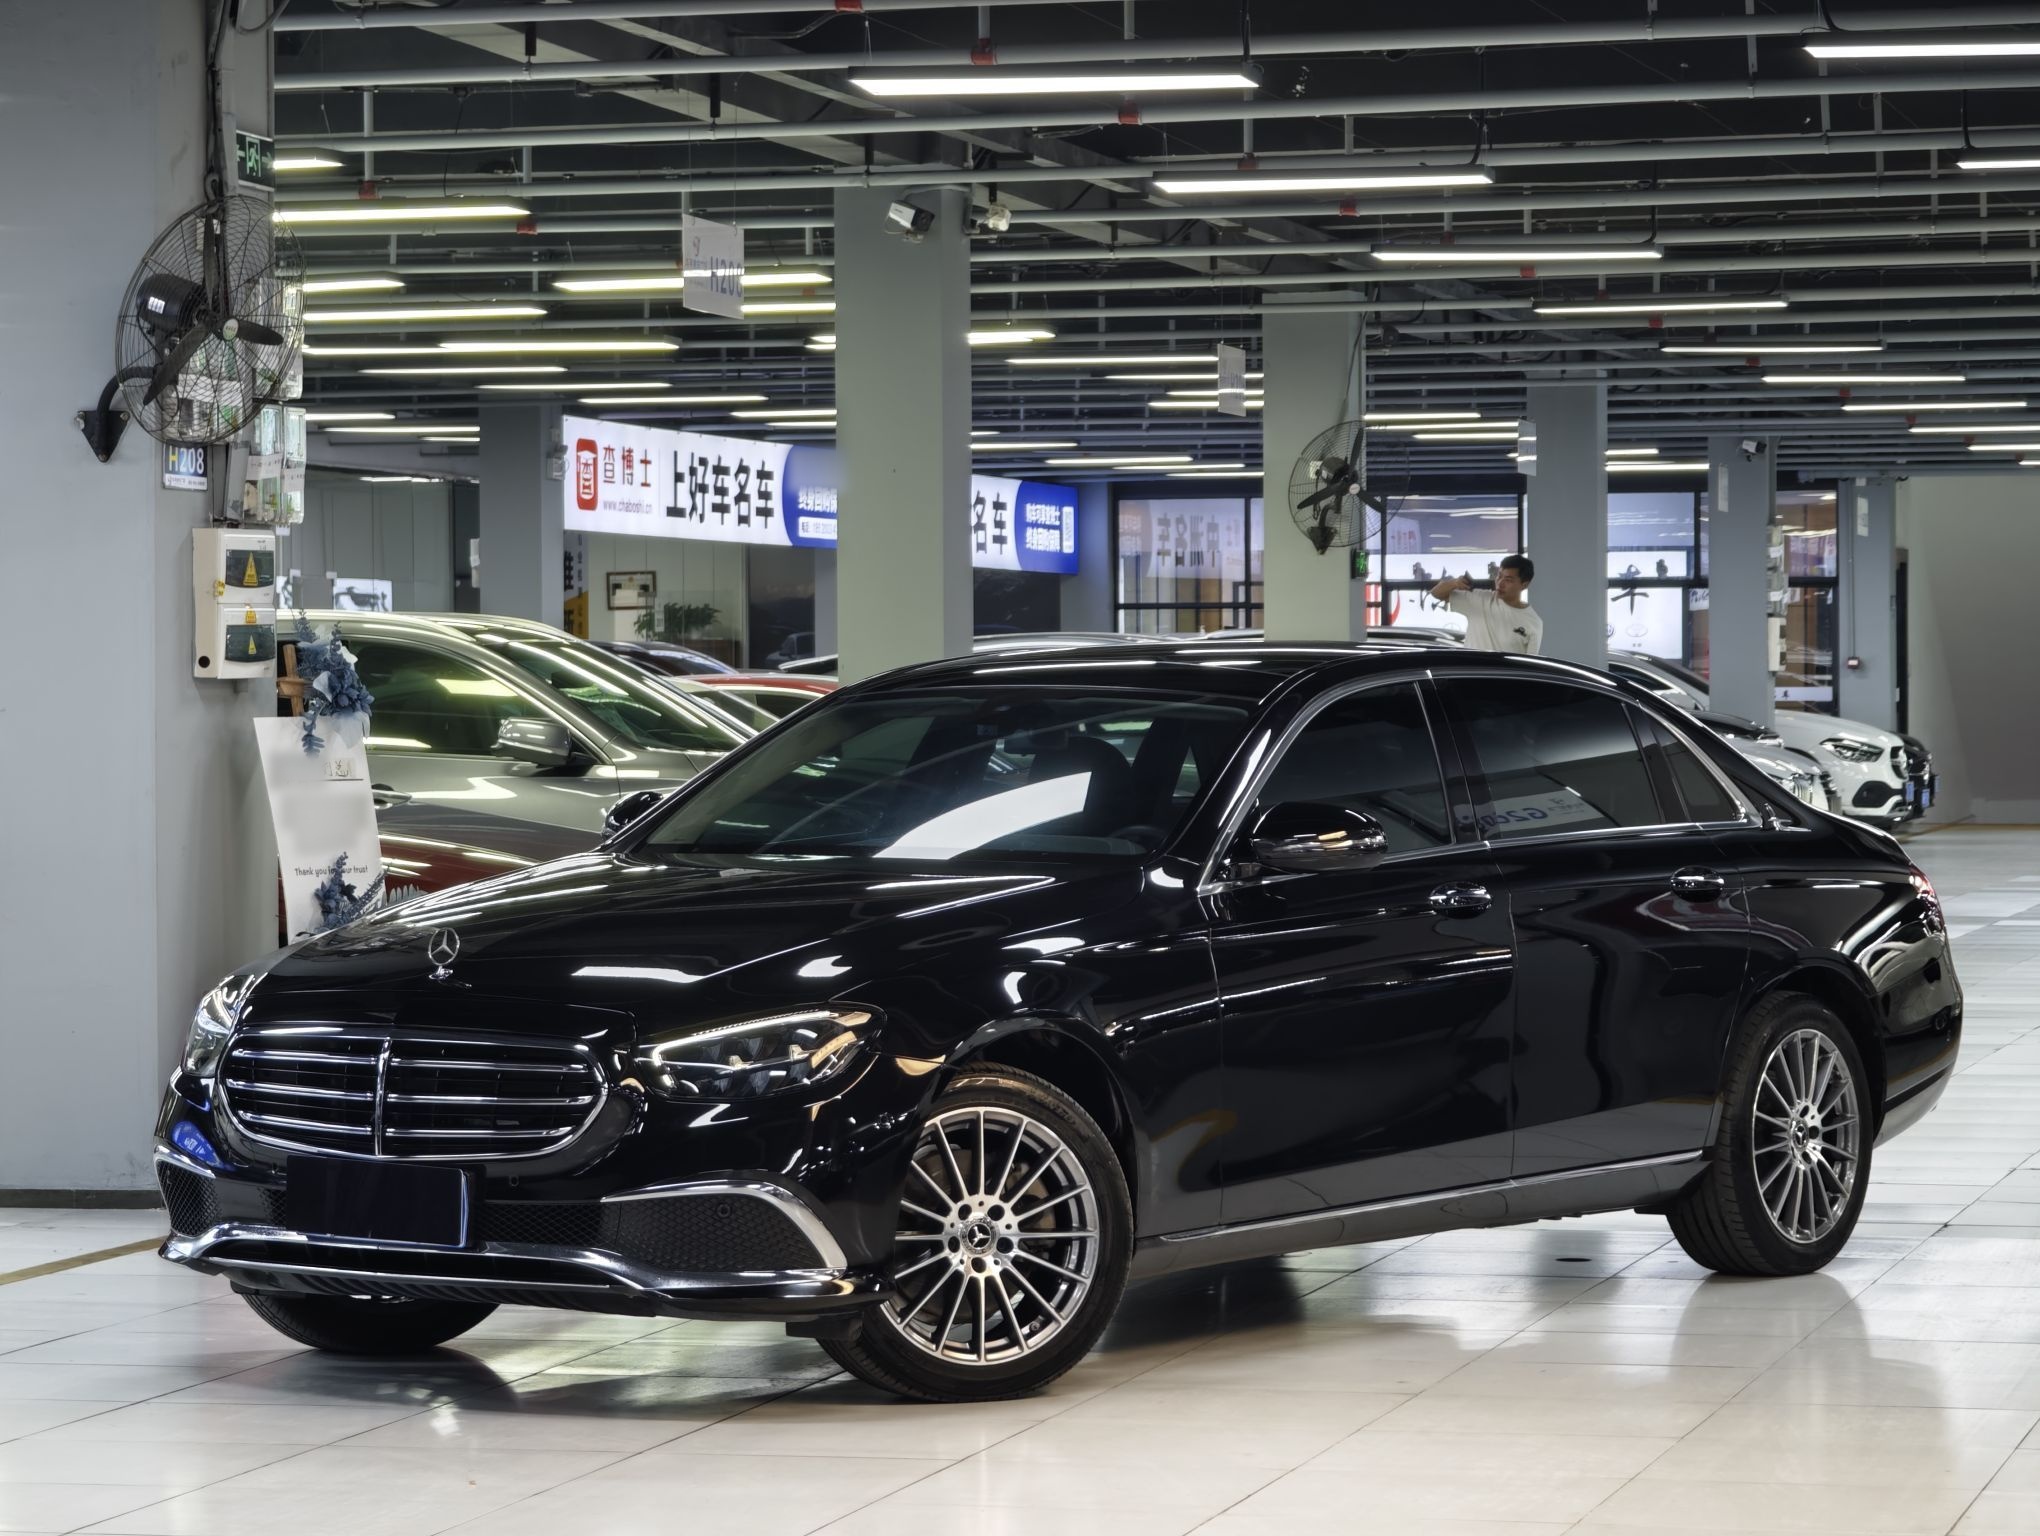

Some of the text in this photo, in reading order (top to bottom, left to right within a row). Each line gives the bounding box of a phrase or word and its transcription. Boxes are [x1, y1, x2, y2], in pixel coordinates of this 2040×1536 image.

[168, 445, 205, 475] H208
[603, 445, 652, 487] 查博士
[666, 450, 775, 530] 上好车名车
[972, 490, 1008, 555] 名车
[295, 867, 314, 876] Thank
[315, 867, 327, 877] you
[353, 865, 368, 873] trust
